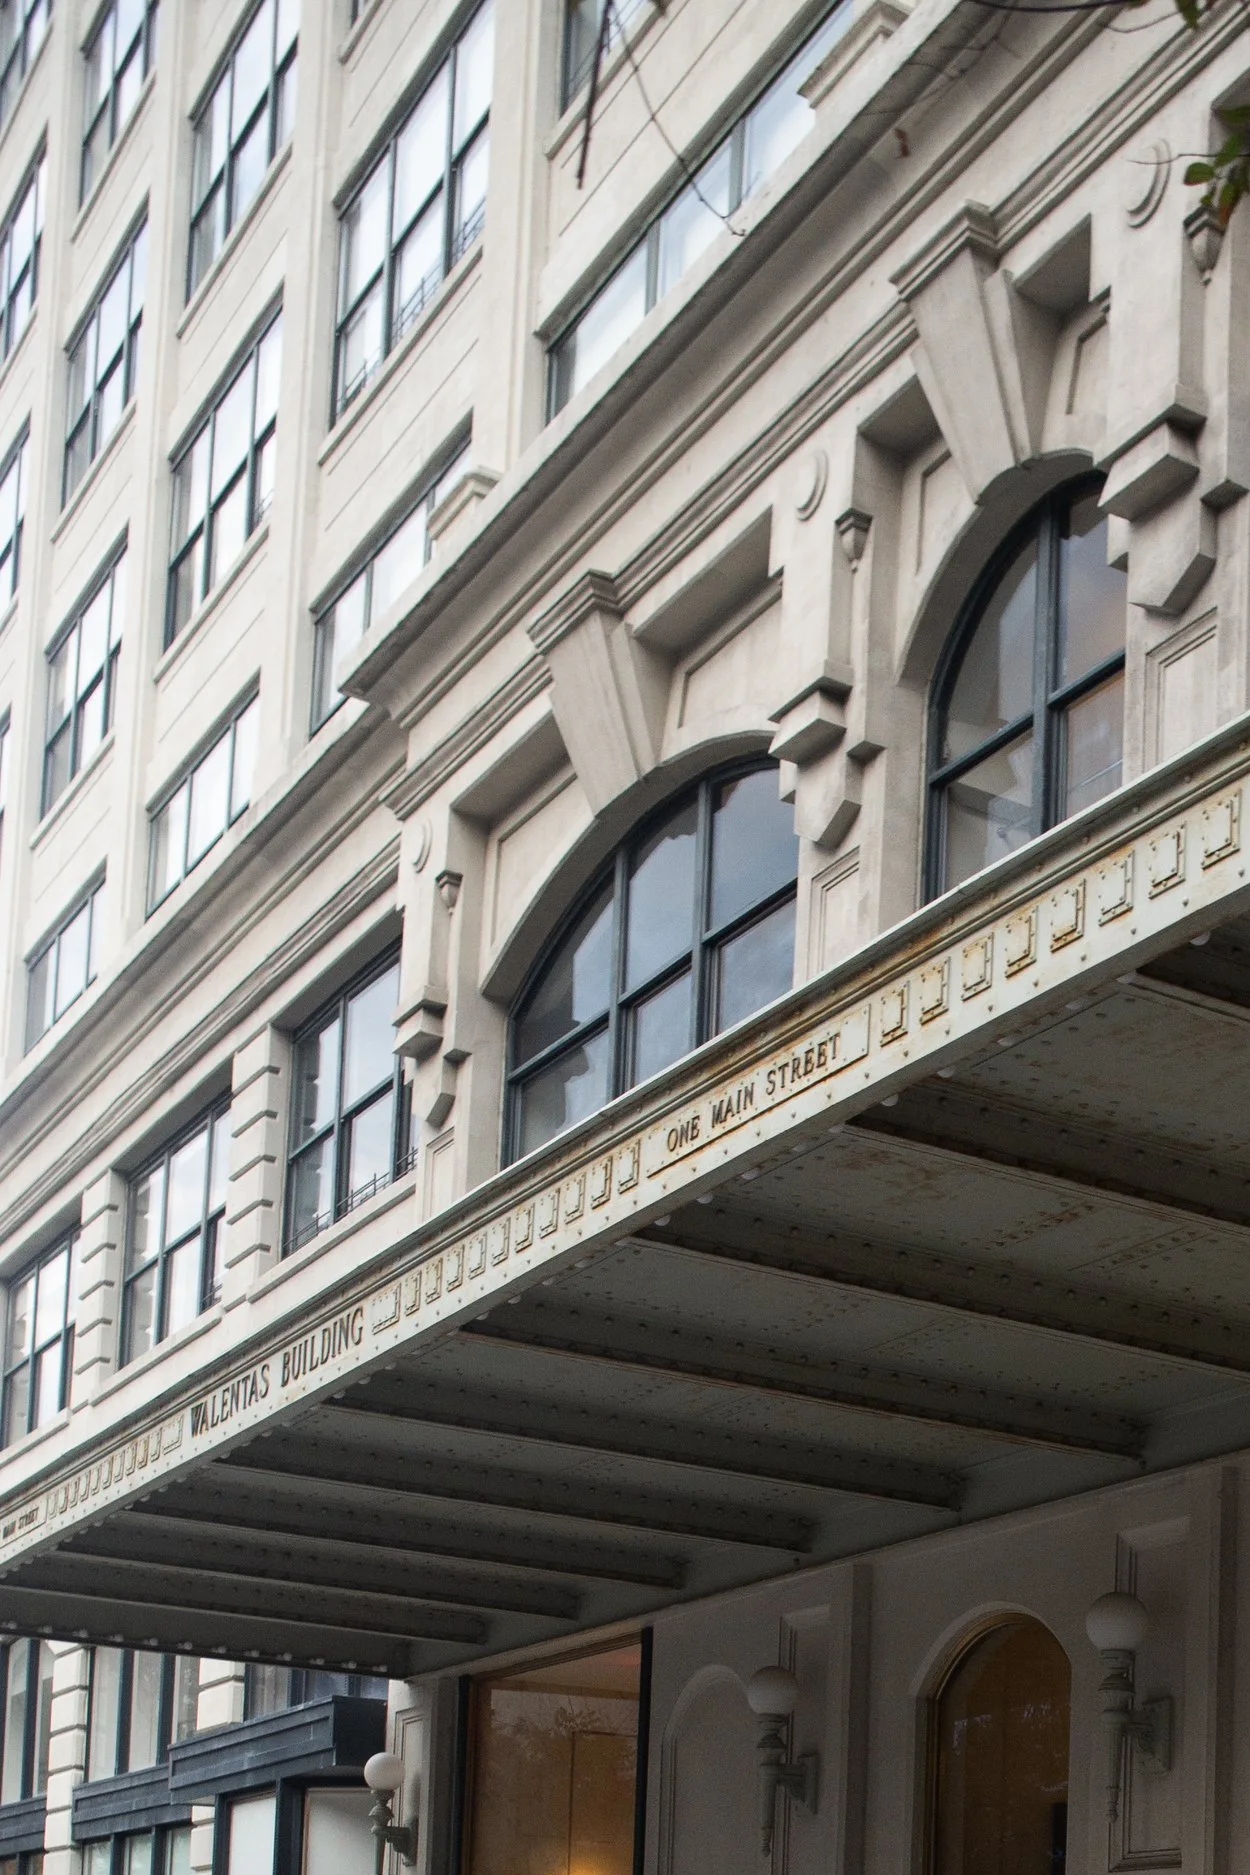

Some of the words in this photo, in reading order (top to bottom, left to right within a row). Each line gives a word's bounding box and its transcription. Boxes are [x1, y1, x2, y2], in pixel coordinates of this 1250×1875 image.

[667, 1114, 701, 1152] ONE
[711, 1082, 755, 1129] MAIN
[765, 1031, 841, 1096] STREET
[191, 1363, 270, 1437] WALENTAS
[281, 1306, 363, 1387] BUILDING
